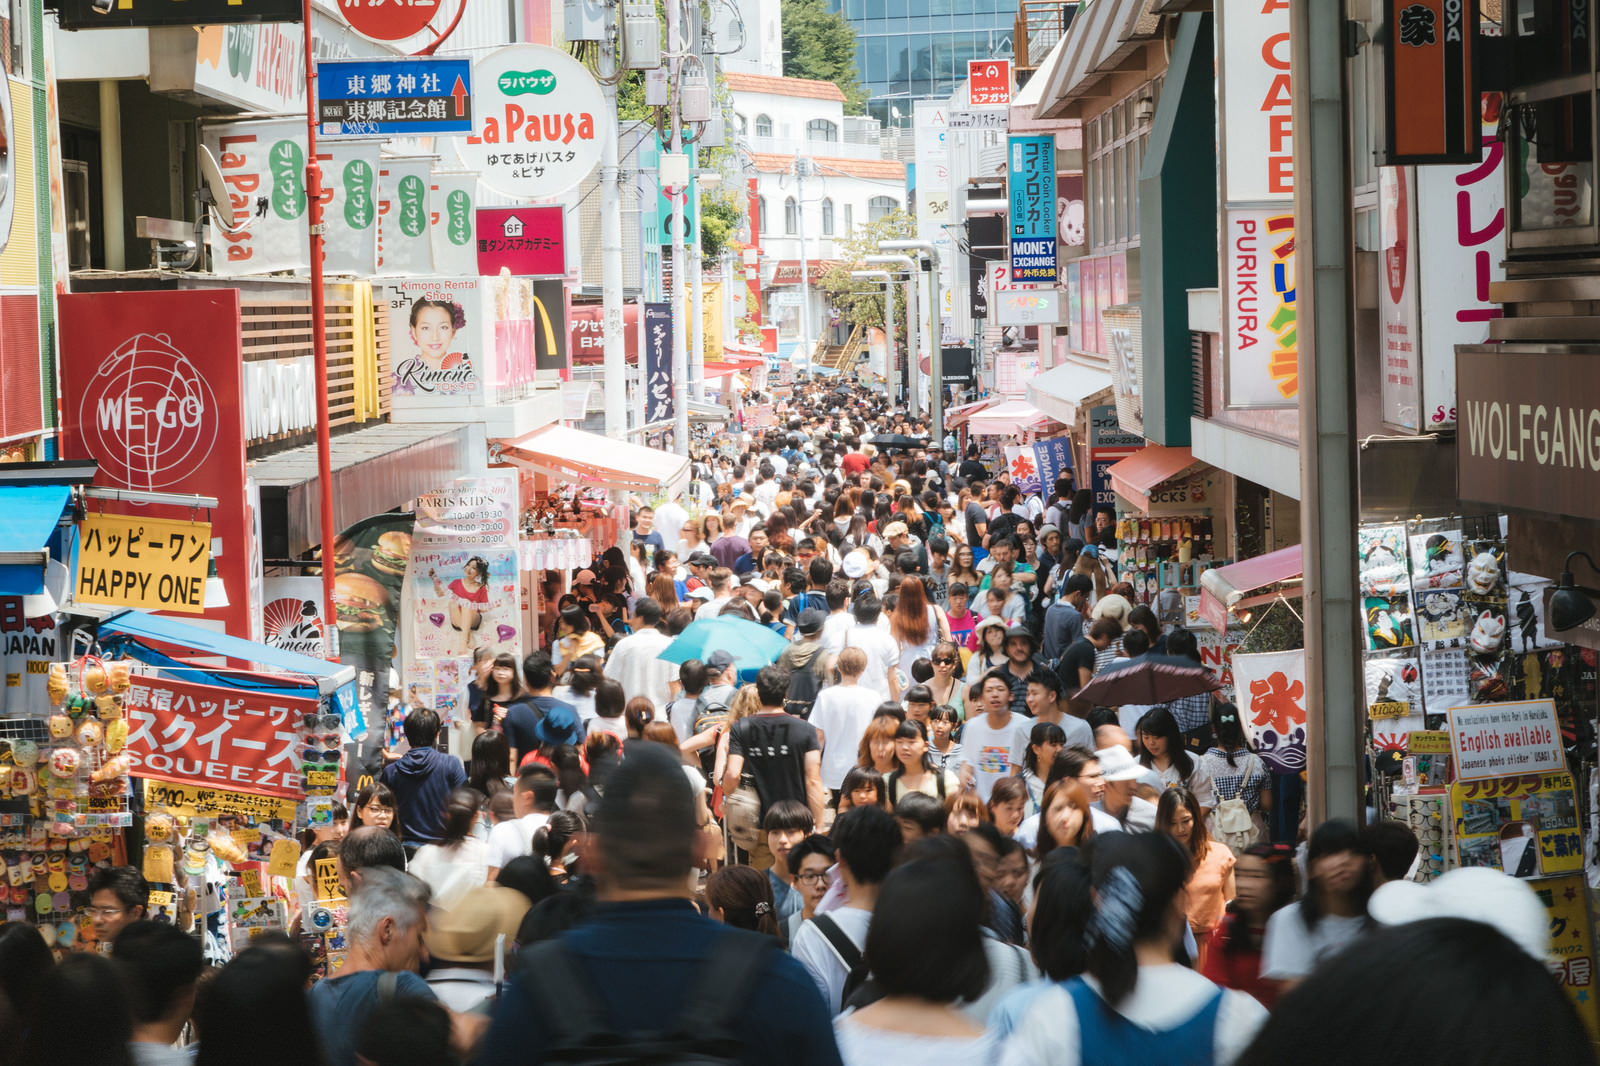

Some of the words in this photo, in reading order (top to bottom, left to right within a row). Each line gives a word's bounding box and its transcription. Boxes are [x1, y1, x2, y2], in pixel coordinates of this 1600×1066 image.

[346, 73, 441, 95] 東郷神社
[346, 99, 447, 121] 東郷記念館
[1260, 32, 1295, 194] CAFE
[467, 116, 499, 144] a
[505, 104, 594, 145] Pausa
[487, 151, 575, 166] ゆであげパスタ
[1041, 142, 1051, 173] Rental
[1025, 143, 1040, 234] コインロッカー
[1042, 176, 1051, 198] Coin
[507, 224, 520, 234] 6F
[1043, 201, 1052, 235] Locker
[1013, 241, 1055, 255] MONEY
[1013, 257, 1056, 267] EXCHANGE
[401, 281, 441, 291] Kimono
[444, 280, 478, 290] Rental
[425, 291, 453, 302] Shop
[1236, 219, 1259, 351] PURIKURA
[391, 301, 406, 309] 3F
[397, 359, 473, 392] Kimono
[99, 397, 145, 430] WE
[155, 395, 201, 429] GO
[1466, 400, 1600, 472] WOLFGANG
[416, 497, 455, 507] PARIS
[460, 495, 494, 507] KID'S
[85, 527, 205, 564] ハッピーワン
[80, 567, 152, 601] HAPPY
[158, 574, 201, 605] ONE
[3, 635, 55, 657] JAPAN
[127, 684, 304, 729] 原宿ハッピーワン
[1460, 729, 1501, 752] English
[1504, 725, 1551, 747] available
[128, 750, 301, 789] SQUEEZE
[1461, 759, 1487, 769] Japanese
[1489, 756, 1504, 767] photo
[1542, 832, 1582, 857] ご案内
